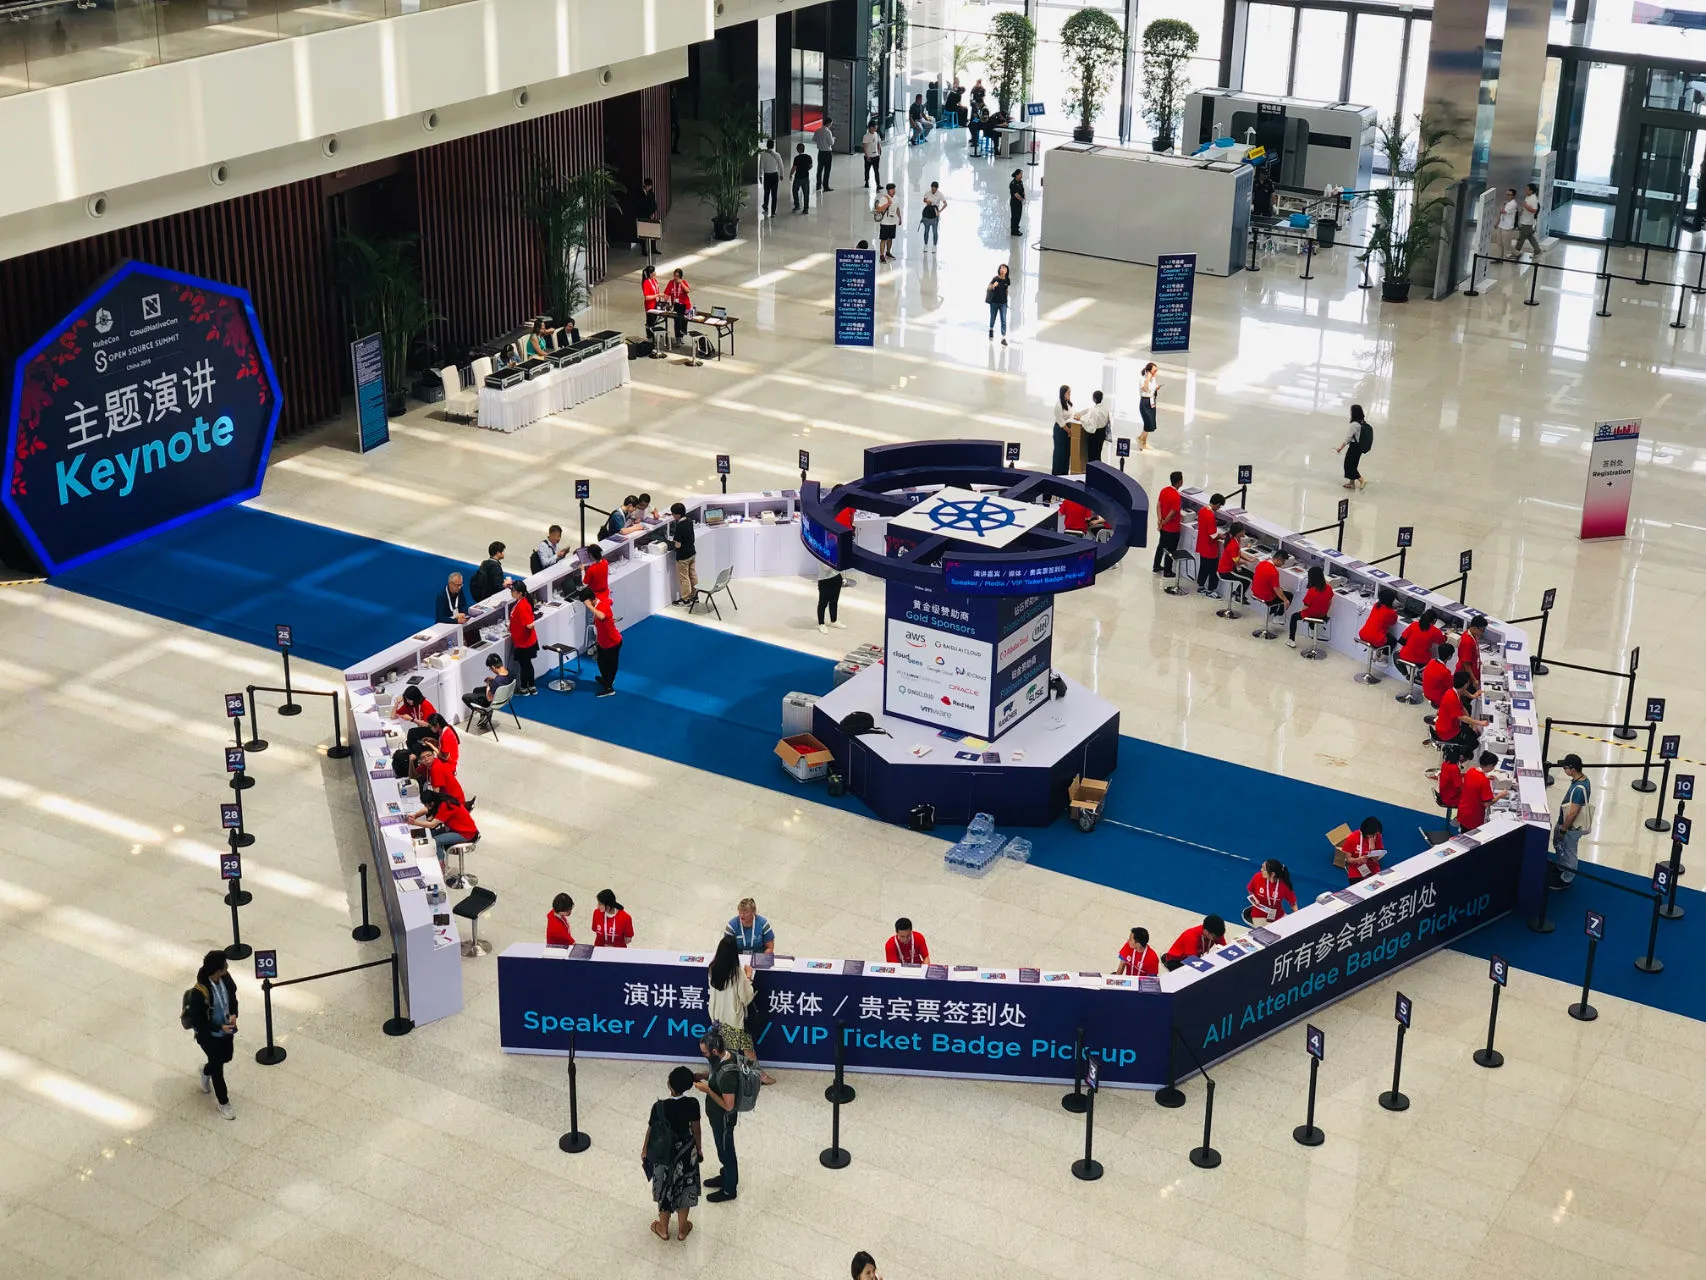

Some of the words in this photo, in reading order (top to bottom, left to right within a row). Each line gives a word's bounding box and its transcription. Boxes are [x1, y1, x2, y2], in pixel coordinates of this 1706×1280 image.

[92, 336, 120, 348] KubeCon
[129, 318, 178, 337] CloudNativeCon
[108, 350, 126, 362] OPEN
[128, 342, 154, 356] SOURCE
[155, 333, 179, 347] SUMMIT
[64, 358, 216, 449] 主题演讲
[55, 414, 234, 506] Keynote
[1240, 470, 1250, 478] 18
[1592, 468, 1631, 477] Registration
[1462, 556, 1470, 565] 15
[985, 579, 1005, 587] Media
[1044, 576, 1064, 584] Badge
[912, 599, 970, 622] 黄金级赞助商
[905, 610, 928, 624] Gold
[931, 616, 976, 635] Sponsors
[1034, 618, 1047, 635] intel
[278, 630, 289, 639] 25
[905, 630, 926, 642] aws
[964, 649, 981, 657] CLOUD
[948, 684, 979, 696] ORACLE
[228, 700, 242, 708] 26
[1649, 704, 1661, 713] 12
[920, 705, 952, 718] vmware
[1665, 742, 1674, 750] 11
[228, 754, 241, 762] 27
[1677, 781, 1690, 790] 10
[224, 810, 238, 819] 28
[1677, 822, 1686, 834] 9
[224, 861, 238, 869] 29
[1658, 872, 1667, 884] 8
[1590, 918, 1600, 929] 7
[1270, 882, 1437, 986] 所有参会者签到处
[258, 958, 273, 967] 30
[1494, 962, 1503, 975] 6
[1202, 1013, 1232, 1049] All
[1240, 966, 1339, 1030] Attendee
[1346, 930, 1412, 976] Badge
[1418, 893, 1490, 940] Pick-up
[623, 982, 710, 1010] 演讲嘉
[768, 990, 823, 1017] 媒体
[832, 995, 849, 1016] /
[859, 995, 1027, 1028] 贵宾票签到处
[1399, 1002, 1407, 1016] 5
[524, 1010, 635, 1036] Speaker
[642, 1015, 658, 1038] /
[757, 1022, 773, 1045] /
[781, 1024, 828, 1044] VIP
[844, 1027, 922, 1051] Ticket
[932, 1033, 1021, 1059] Badge
[1311, 1035, 1319, 1047] 4
[1090, 1065, 1096, 1079] 3
